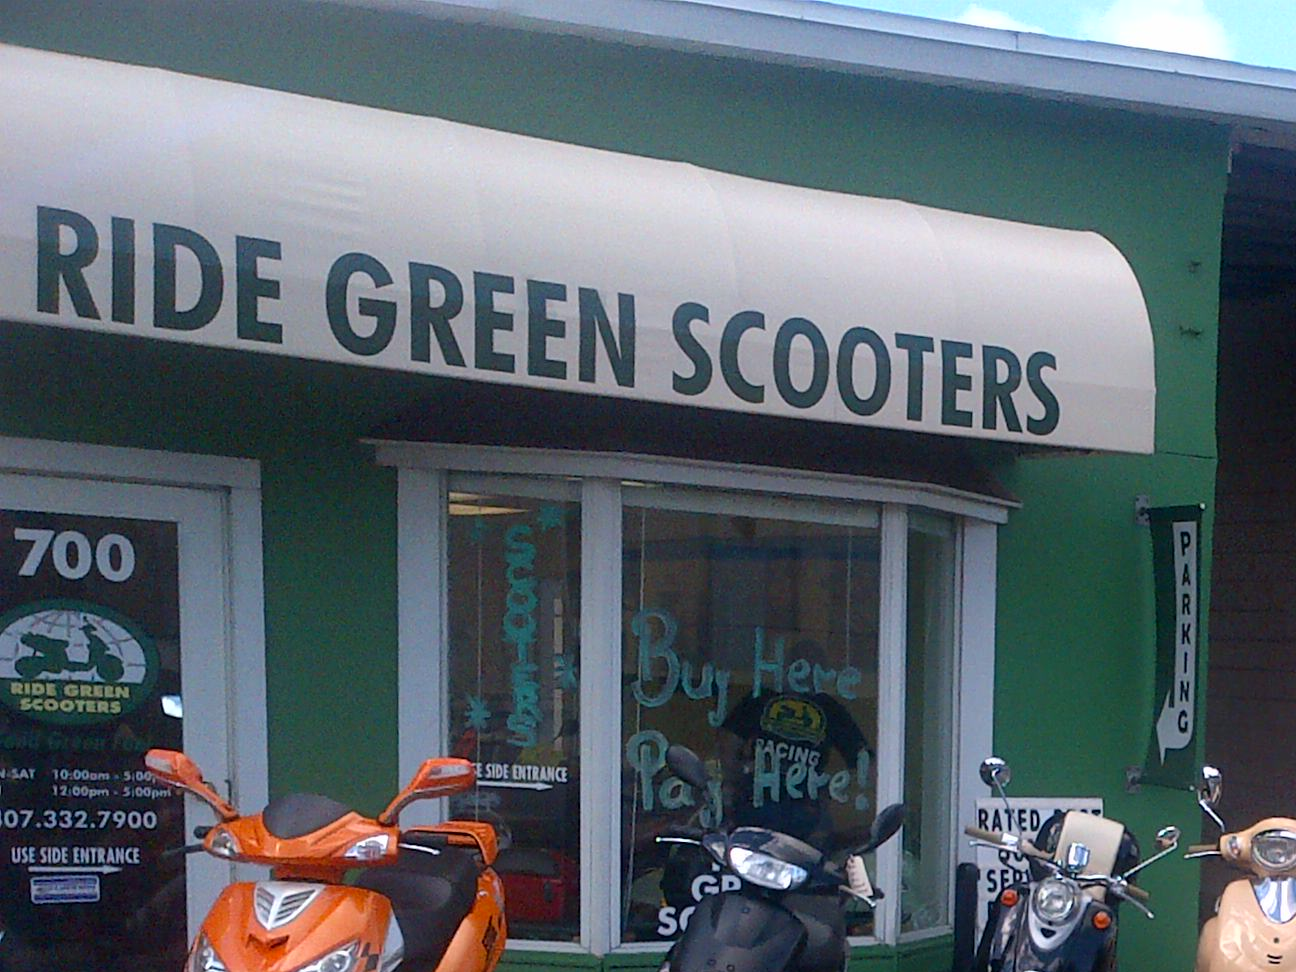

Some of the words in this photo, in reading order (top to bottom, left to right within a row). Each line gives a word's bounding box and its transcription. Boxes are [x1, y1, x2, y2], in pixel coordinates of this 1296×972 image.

[36, 204, 284, 344] RIDE
[325, 251, 636, 388] GREEN
[671, 301, 1060, 436] SCOOTERS
[14, 528, 136, 583] 700
[1178, 530, 1192, 734] PARKING
[631, 607, 731, 728] Buy
[752, 626, 862, 700] Here
[10, 682, 56, 697] RIDE
[63, 683, 130, 699] GREEN
[19, 698, 122, 714] SCOOTERS
[756, 739, 821, 766] RACING
[484, 764, 509, 780] SIDE
[512, 765, 568, 783] ENTRANCE
[626, 730, 723, 829] Pay
[752, 748, 870, 810] Here!
[123, 786, 172, 799] 5:00pm
[978, 808, 1041, 832] RATED
[11, 847, 36, 864] USE
[40, 847, 69, 865] SIDE
[73, 847, 141, 865] ENTRANCE
